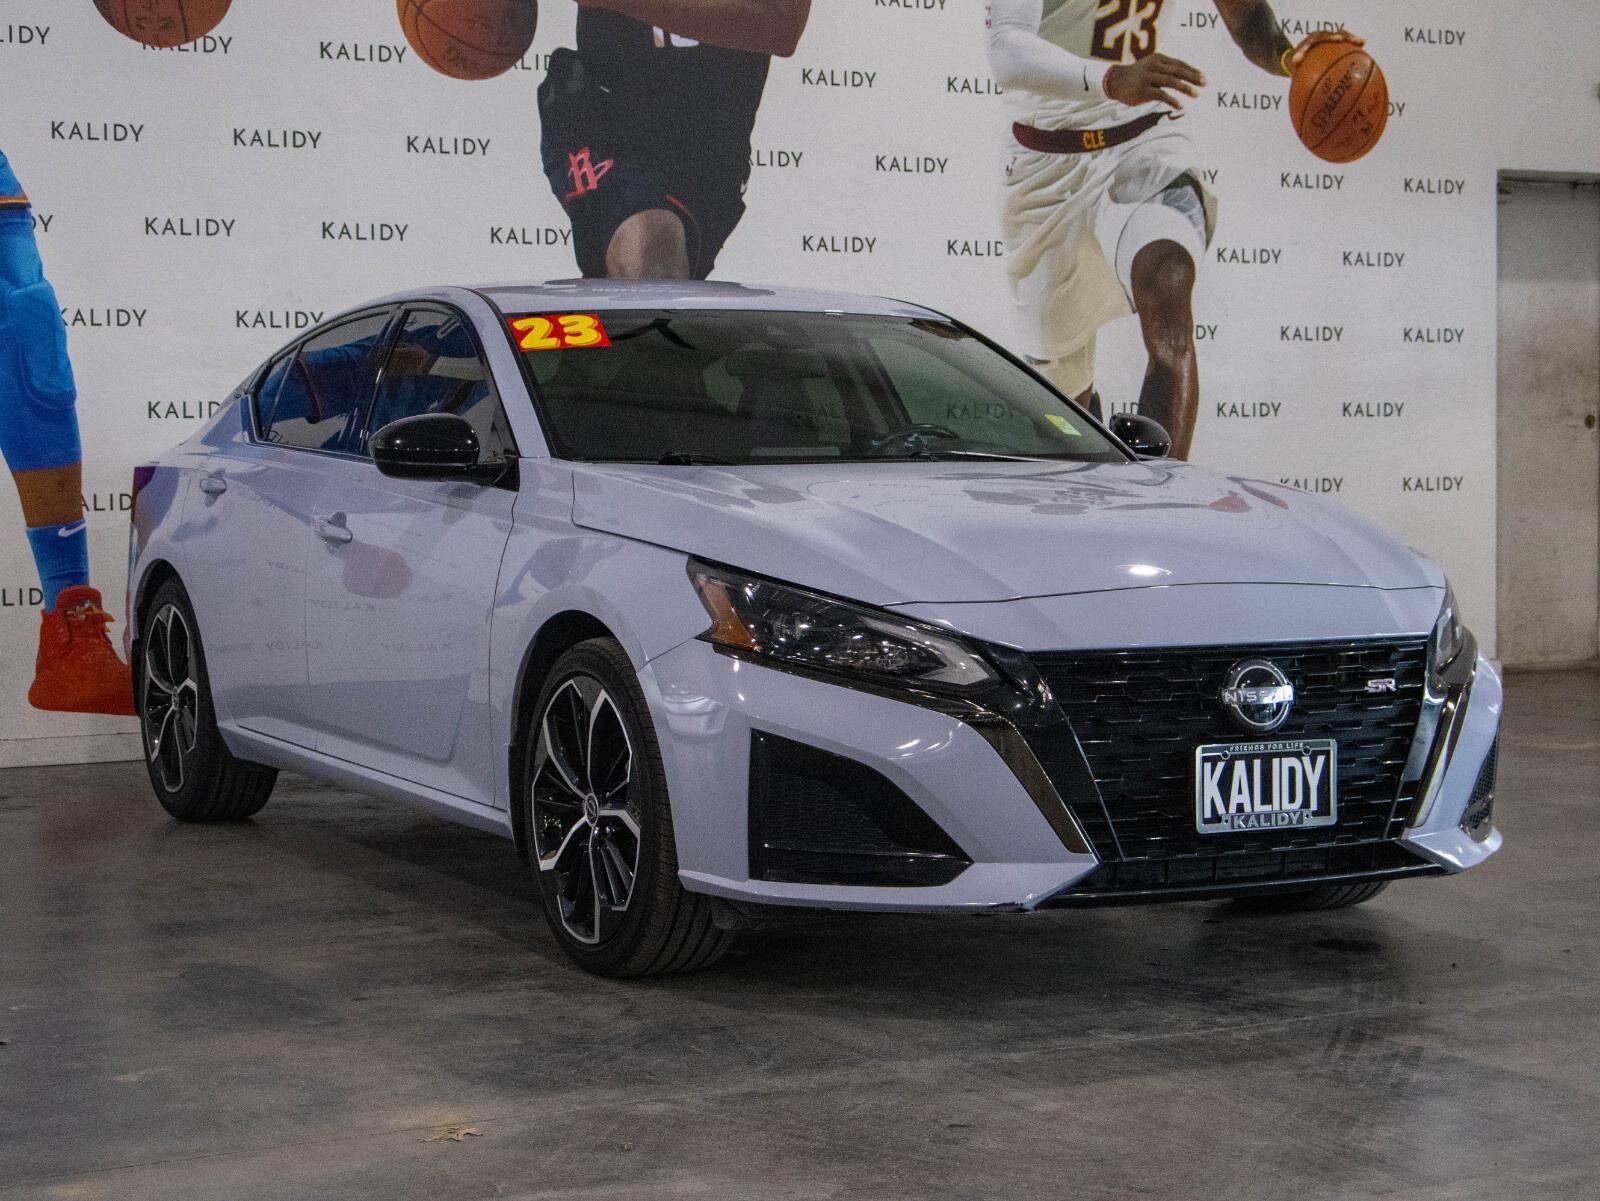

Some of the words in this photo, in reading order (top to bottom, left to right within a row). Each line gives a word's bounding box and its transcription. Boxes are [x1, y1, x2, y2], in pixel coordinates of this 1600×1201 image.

[142, 36, 233, 54] LIDY
[1404, 27, 1466, 45] KALIDY
[320, 41, 407, 64] KALIDY
[802, 68, 877, 88] KALIDY
[1217, 92, 1282, 110] KALIDY
[51, 120, 144, 143] KALIDY
[233, 128, 322, 149] KALIDY
[1082, 131, 1106, 149] CLE
[407, 135, 491, 156] KALIDY
[750, 150, 804, 168] LIDY
[876, 155, 948, 174] KALIDY
[1281, 173, 1344, 190] KALIDY
[1404, 178, 1465, 195] KALIDY
[145, 216, 236, 237] KALIDY
[321, 221, 409, 242] KALIDY
[490, 226, 572, 246] KALIDY
[802, 235, 877, 253] KALIDY
[1217, 247, 1282, 264] KALIDY
[1342, 251, 1405, 268] KALIDY
[513, 315, 602, 349] 23
[1281, 326, 1344, 342] KALIDY
[1403, 328, 1464, 343] KALIDY
[1216, 402, 1281, 418] KALIDY
[1342, 402, 1404, 418] KALIDY
[1403, 476, 1463, 492] KALIDY
[1225, 686, 1293, 703] NISS
[1229, 744, 1265, 752] FRIENDS
[1203, 755, 1326, 819] KALIDY
[1233, 812, 1300, 829] KALIDY
